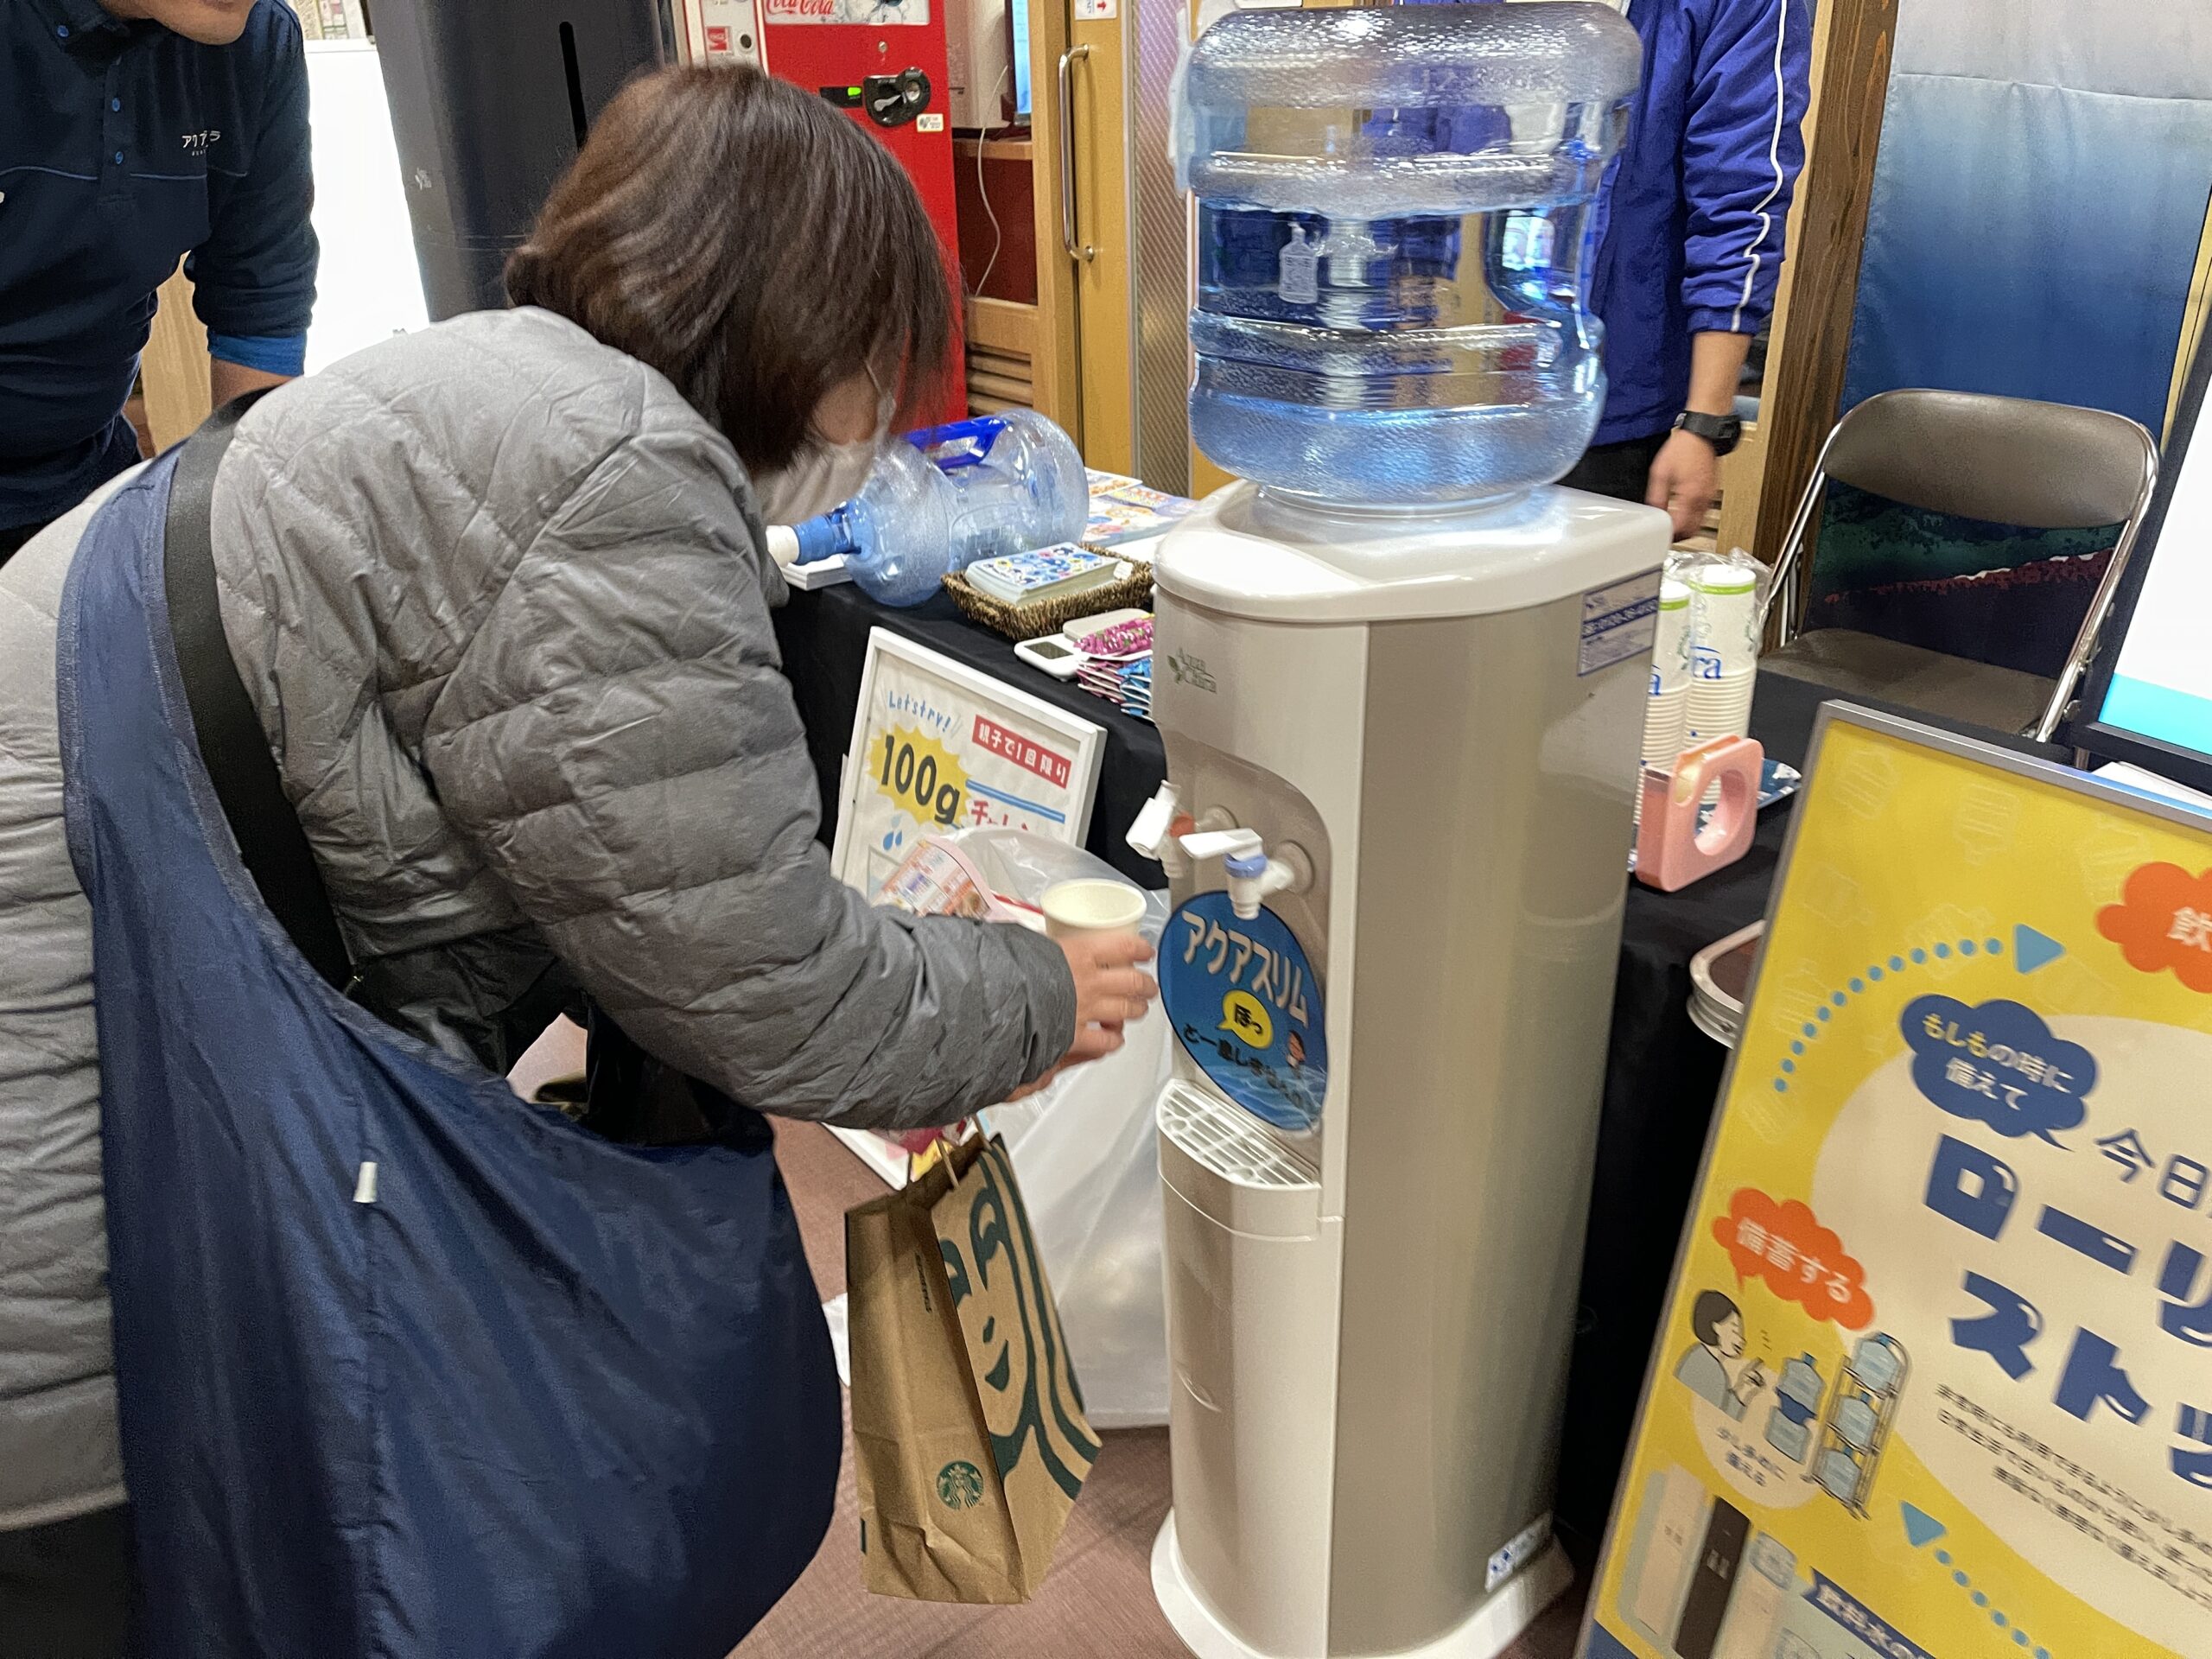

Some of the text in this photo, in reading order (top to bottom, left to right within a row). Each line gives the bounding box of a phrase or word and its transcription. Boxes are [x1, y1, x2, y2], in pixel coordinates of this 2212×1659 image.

[881, 734, 961, 824] 100g
[1181, 910, 1310, 1030] アクアスリム
[1923, 1012, 2075, 1094] もしもの時に
[1945, 1056, 2029, 1111] 備えて
